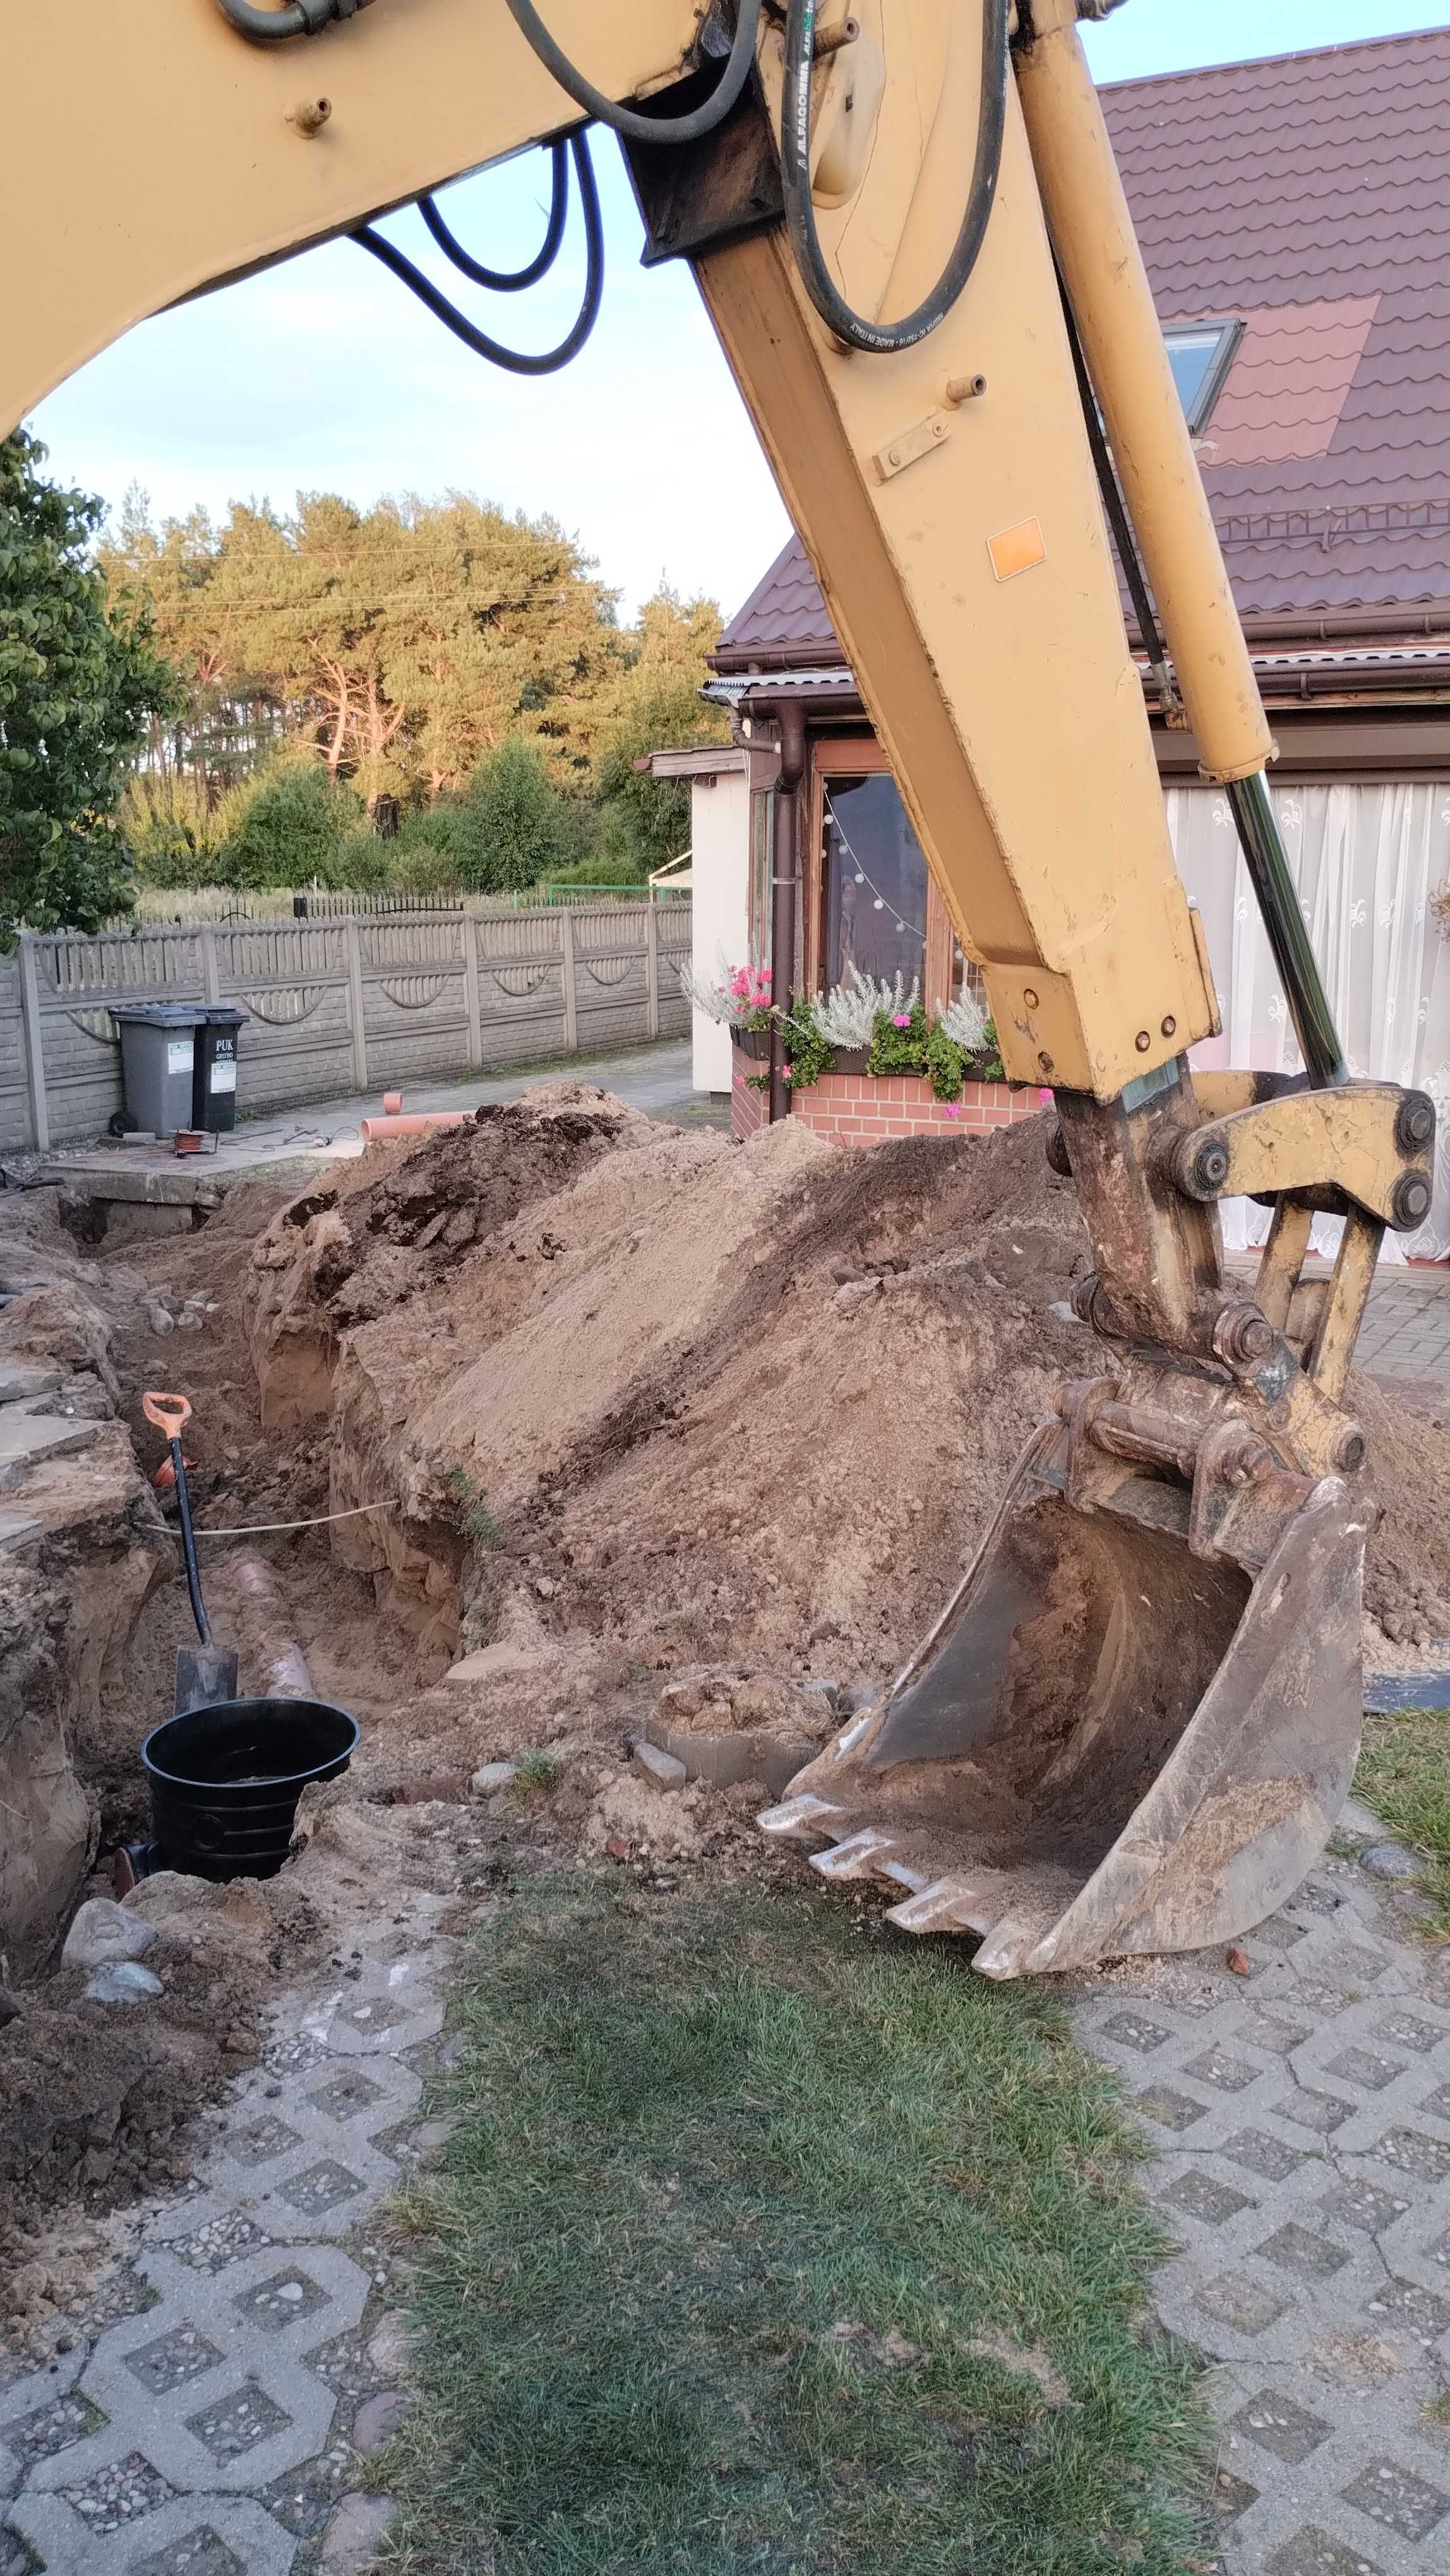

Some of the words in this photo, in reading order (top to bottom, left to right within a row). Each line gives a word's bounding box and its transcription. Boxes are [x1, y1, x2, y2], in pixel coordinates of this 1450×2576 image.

[798, 60, 809, 155] ALFAGOMMA
[849, 323, 869, 340] ITALY
[867, 333, 875, 344] IN
[873, 335, 895, 348] MADE
